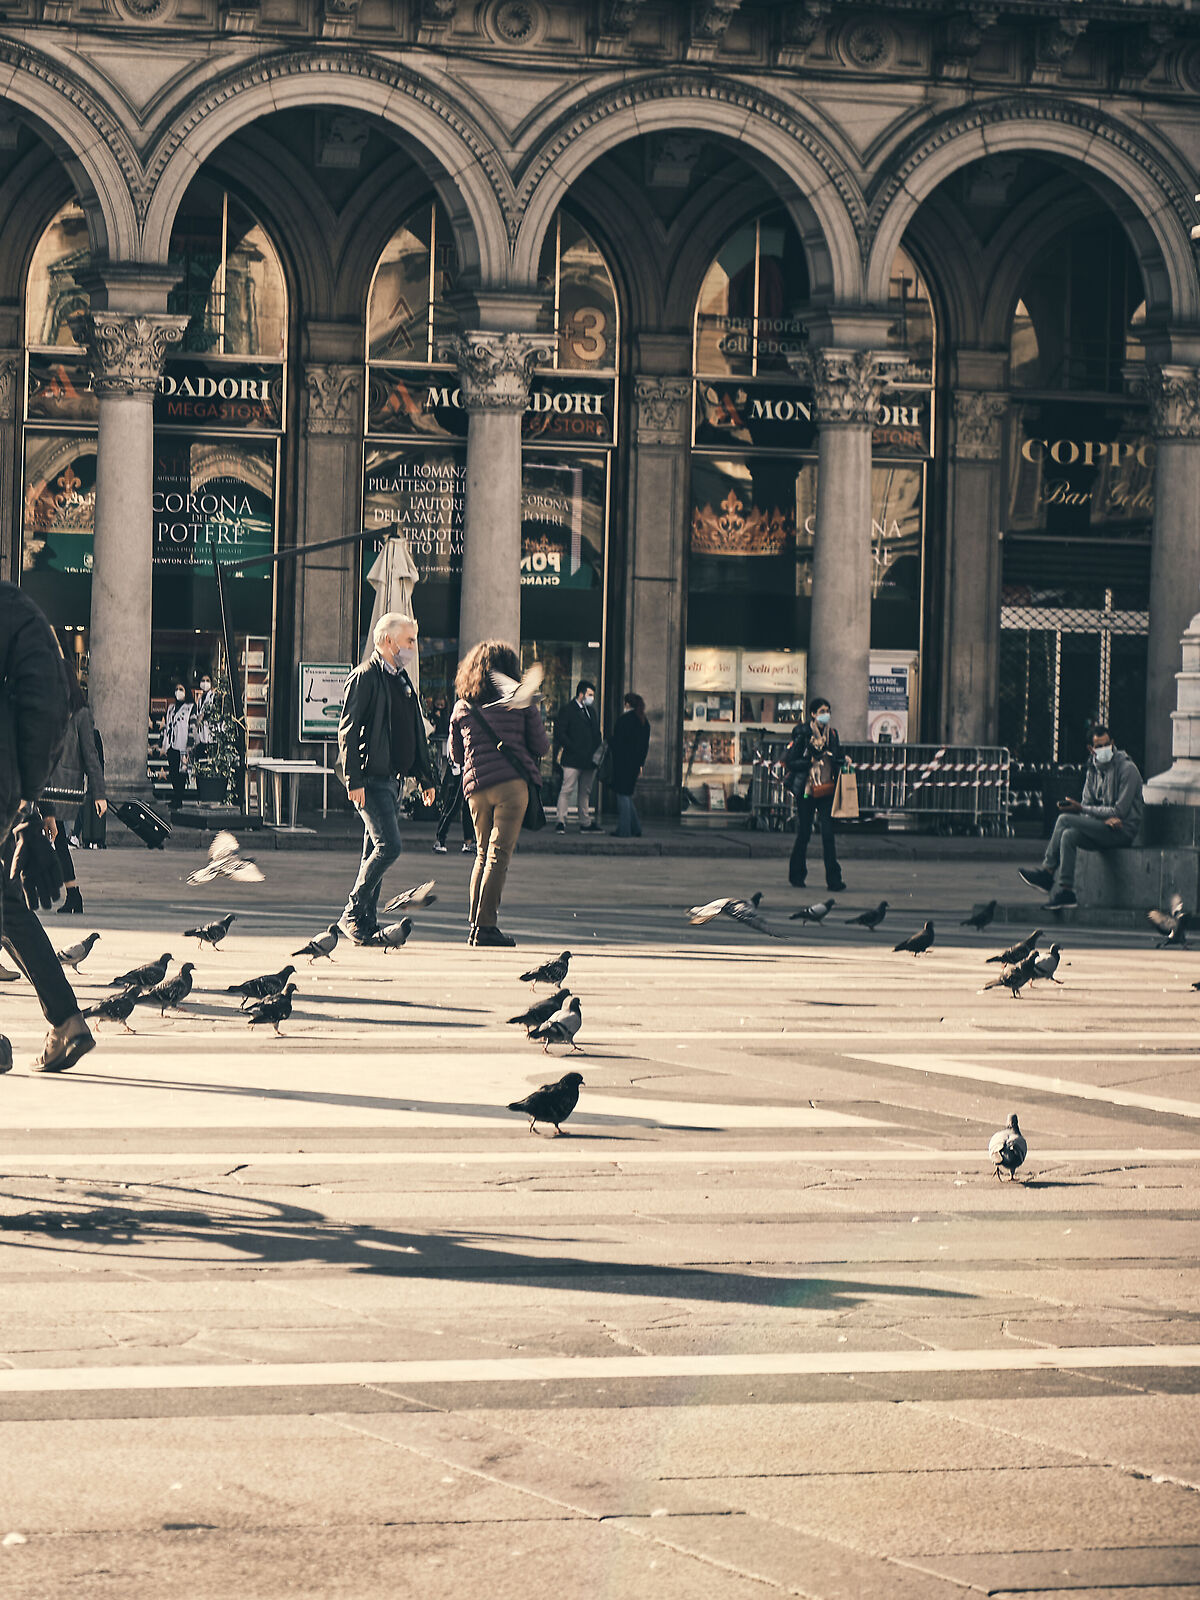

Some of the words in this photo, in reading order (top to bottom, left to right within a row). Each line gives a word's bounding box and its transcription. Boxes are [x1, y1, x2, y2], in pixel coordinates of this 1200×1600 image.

[84, 371, 271, 400] DADORI
[168, 402, 273, 420] MEGASTORE
[751, 400, 920, 426] MONORI
[399, 464, 409, 477] IL
[369, 476, 389, 492] PIÙ
[391, 479, 436, 493] ATTESO
[1039, 480, 1093, 506] Bar
[152, 492, 254, 516] CORONA
[374, 509, 411, 523] DELLA
[413, 510, 445, 524] SAGA
[159, 522, 244, 545] POTERE
[435, 542, 446, 555] IL
[747, 664, 770, 674] Scelti
